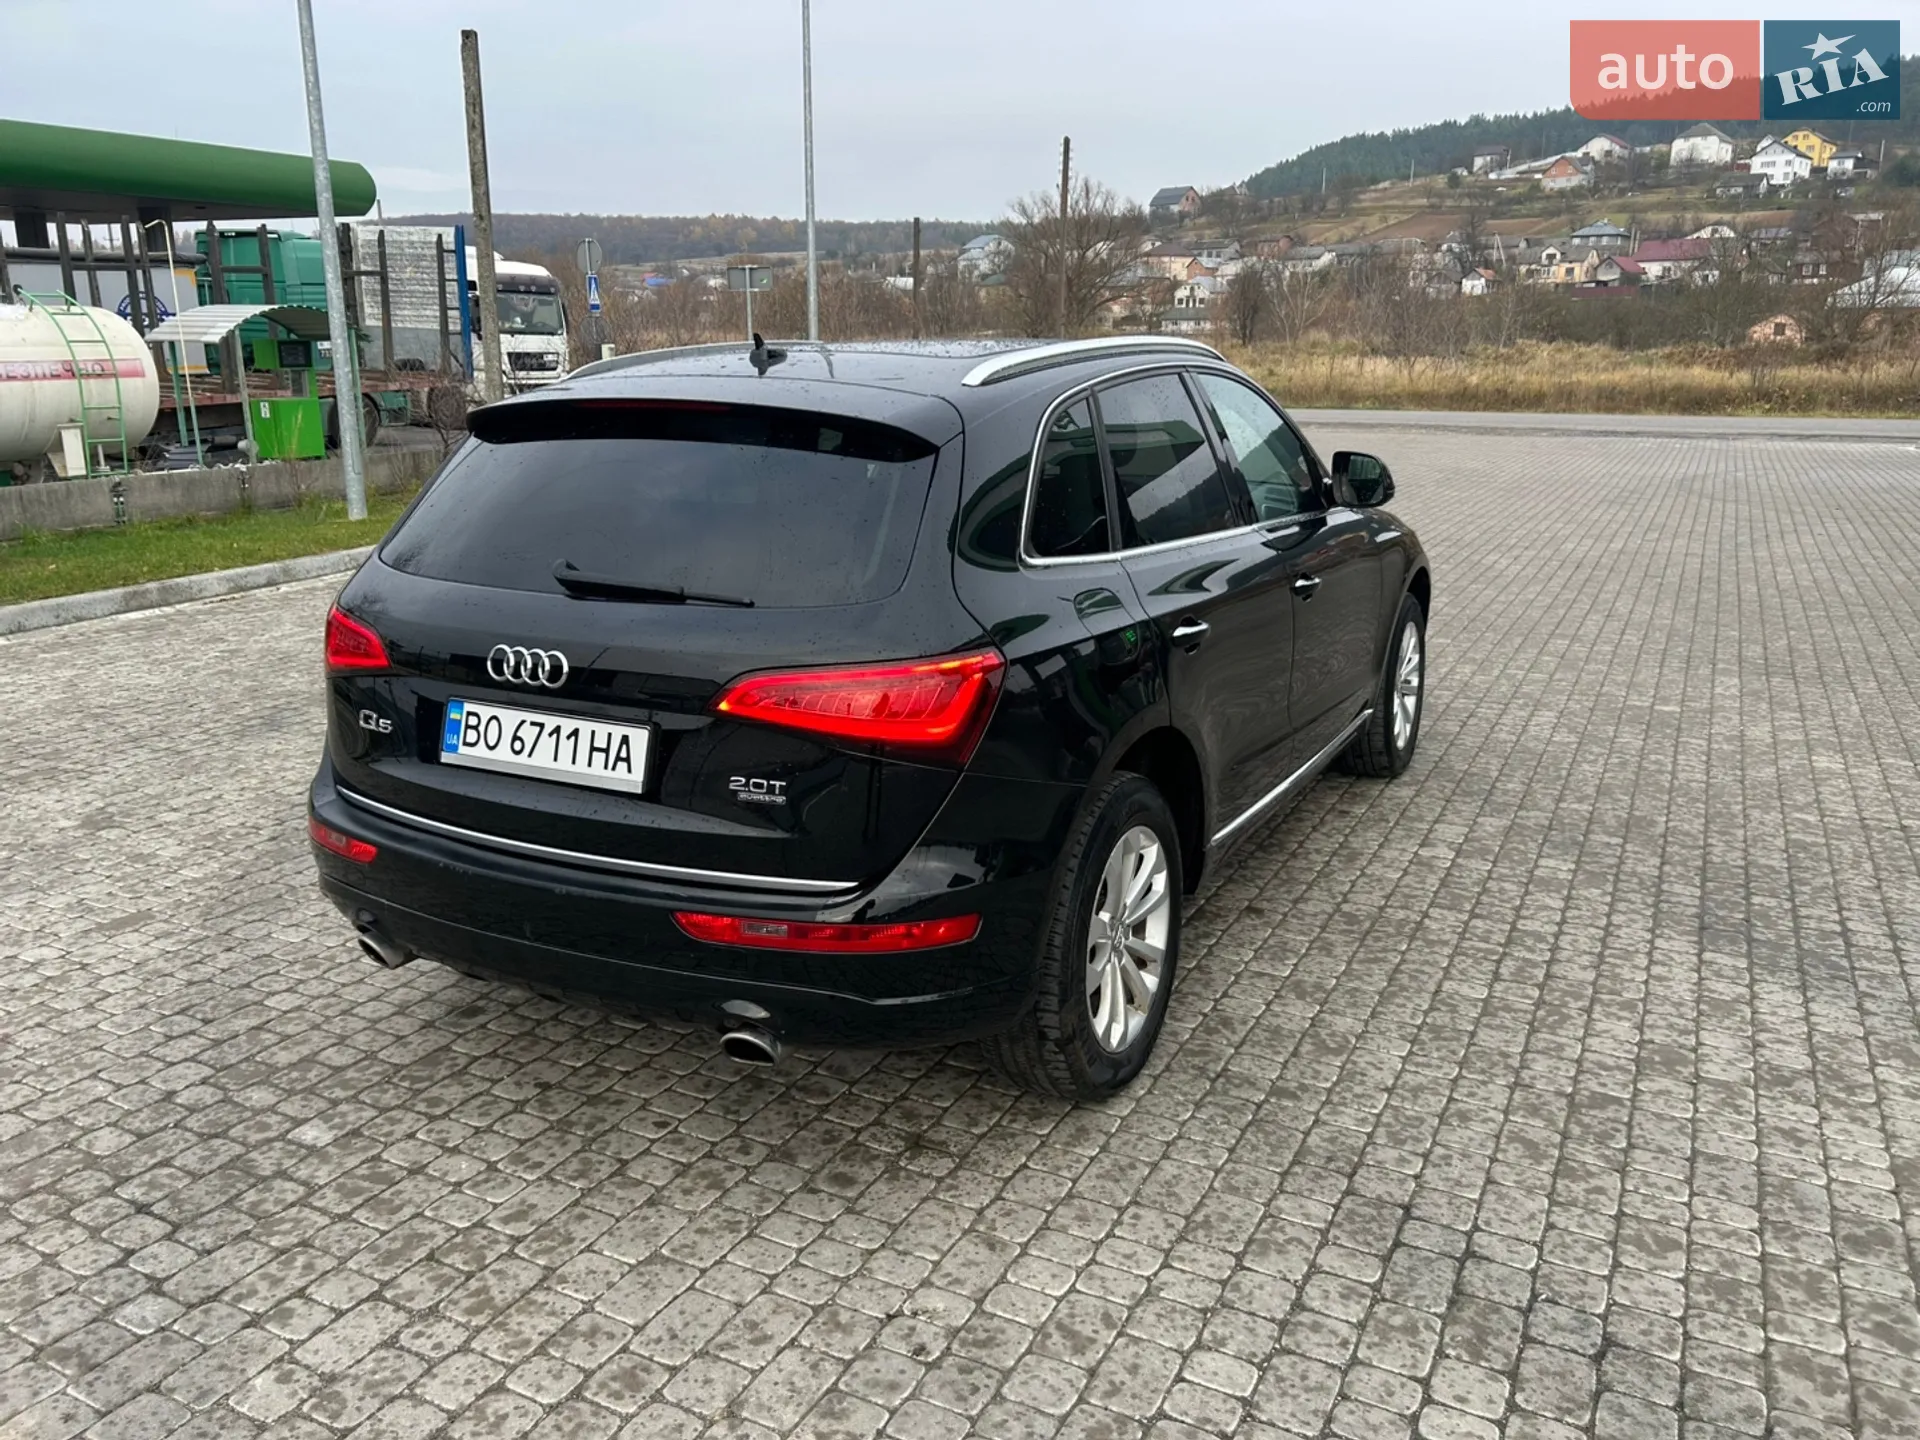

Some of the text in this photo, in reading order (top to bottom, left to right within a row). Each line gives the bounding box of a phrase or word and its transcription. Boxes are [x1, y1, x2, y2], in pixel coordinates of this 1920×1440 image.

[0, 362, 105, 378] ЕЗПЕЧНО
[359, 709, 393, 734] Q5
[446, 733, 458, 745] UA
[462, 711, 633, 774] BO 6711 HA
[729, 776, 787, 795] 2.0T
